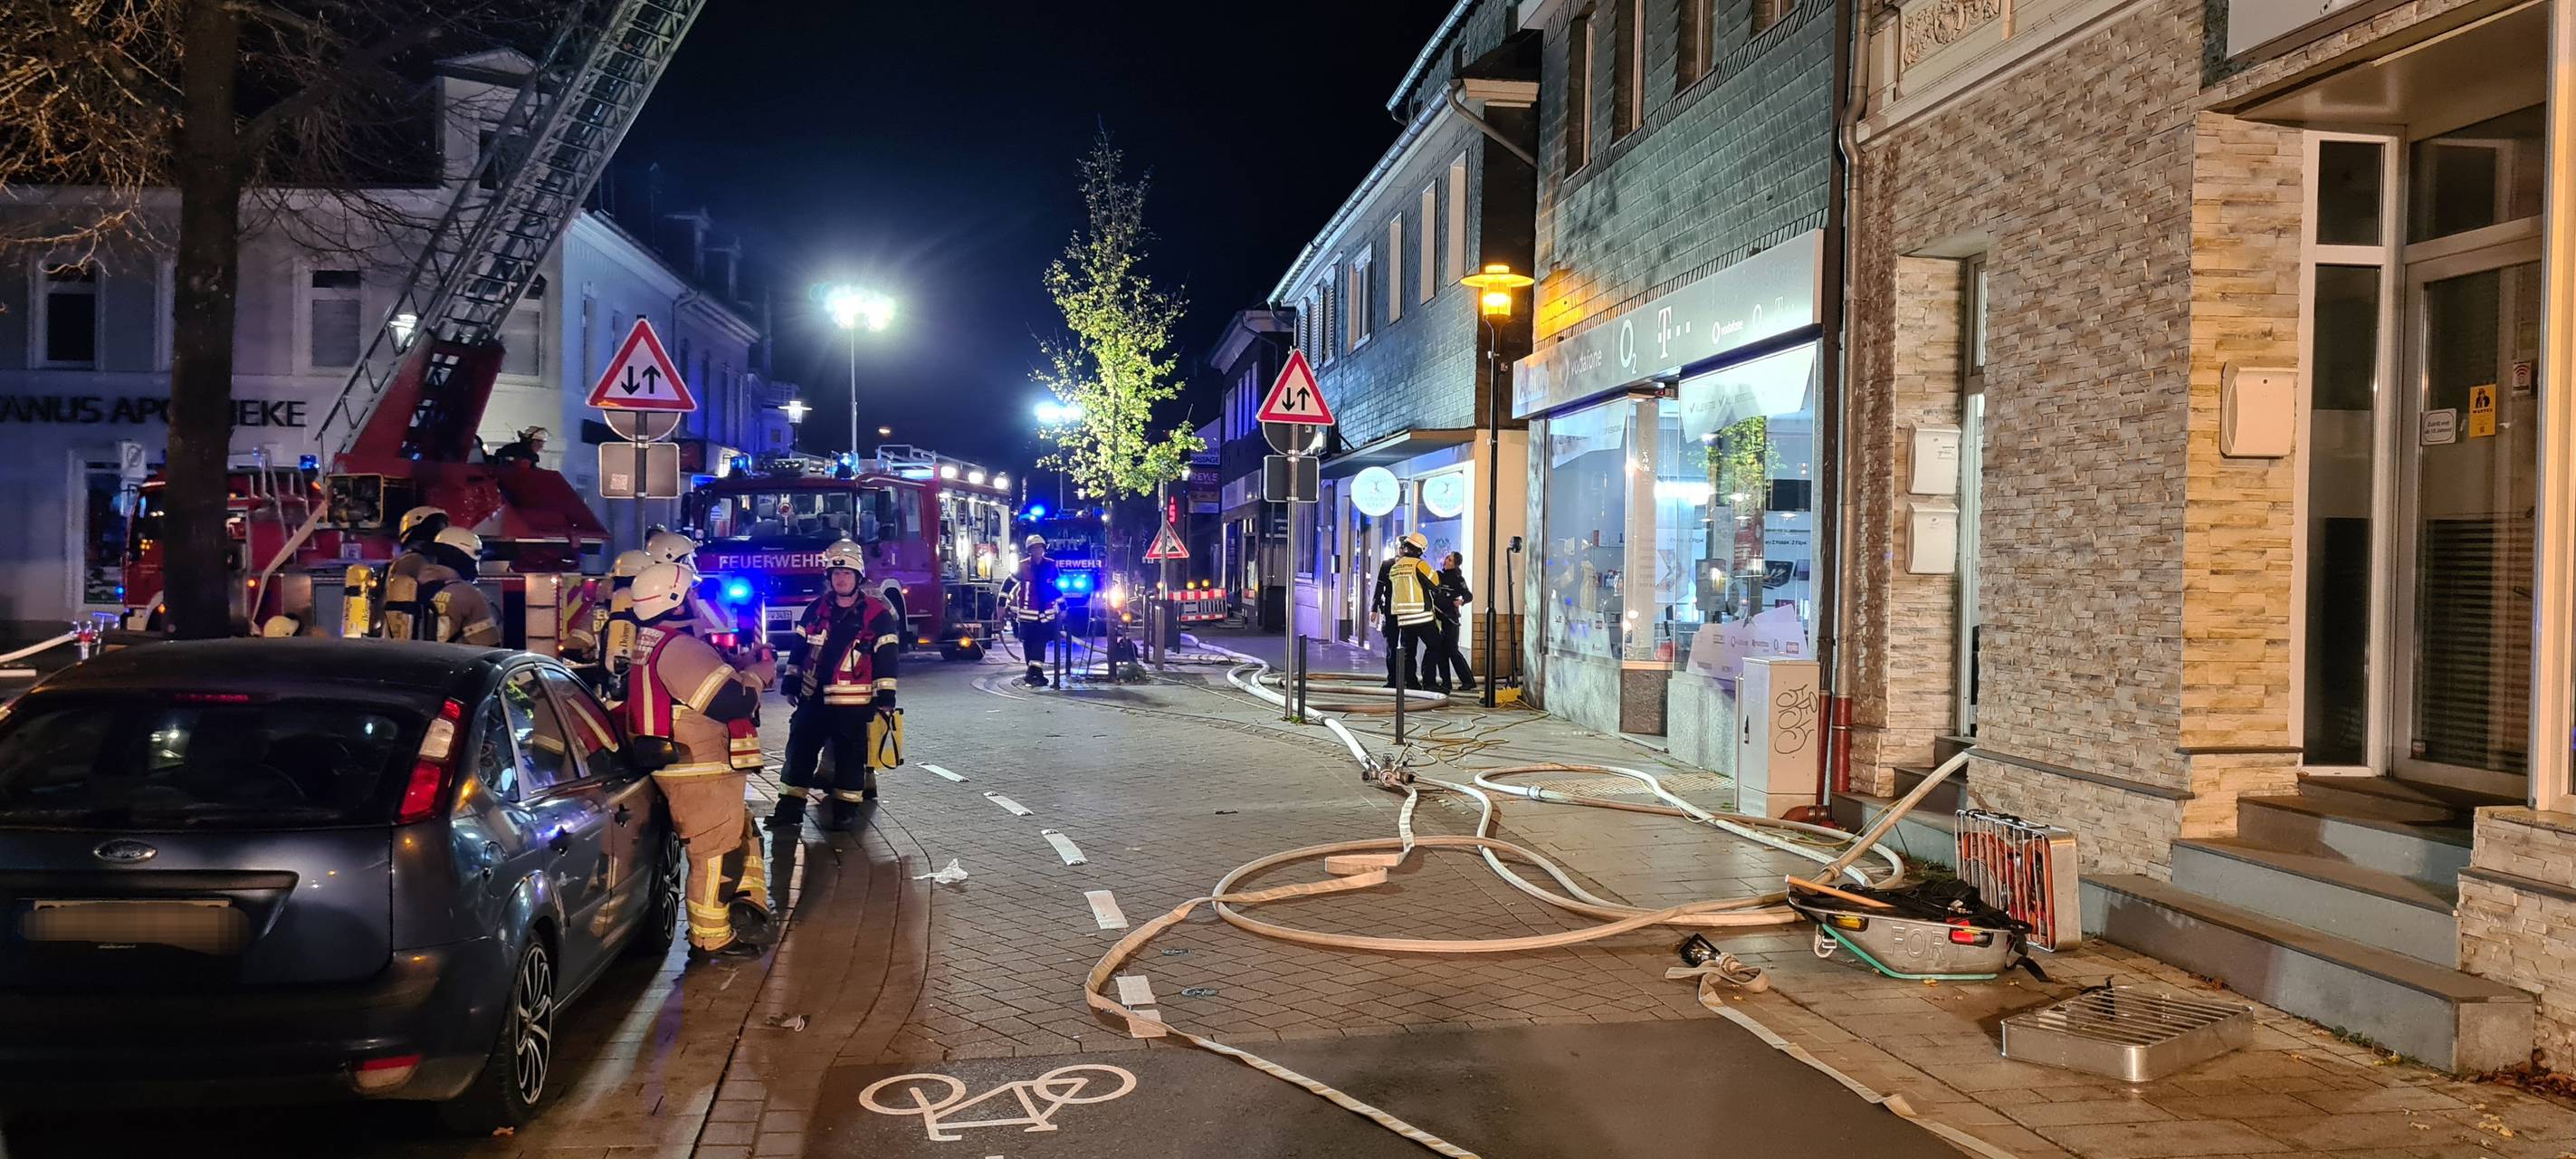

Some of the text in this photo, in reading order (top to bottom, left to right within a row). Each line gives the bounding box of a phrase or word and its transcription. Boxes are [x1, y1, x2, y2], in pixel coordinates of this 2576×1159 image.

[1570, 348, 1603, 376] vodafone
[0, 396, 307, 428] ANUS APEKE
[719, 553, 825, 570] FEUERWEHR
[1055, 559, 1102, 569] ERWEHR
